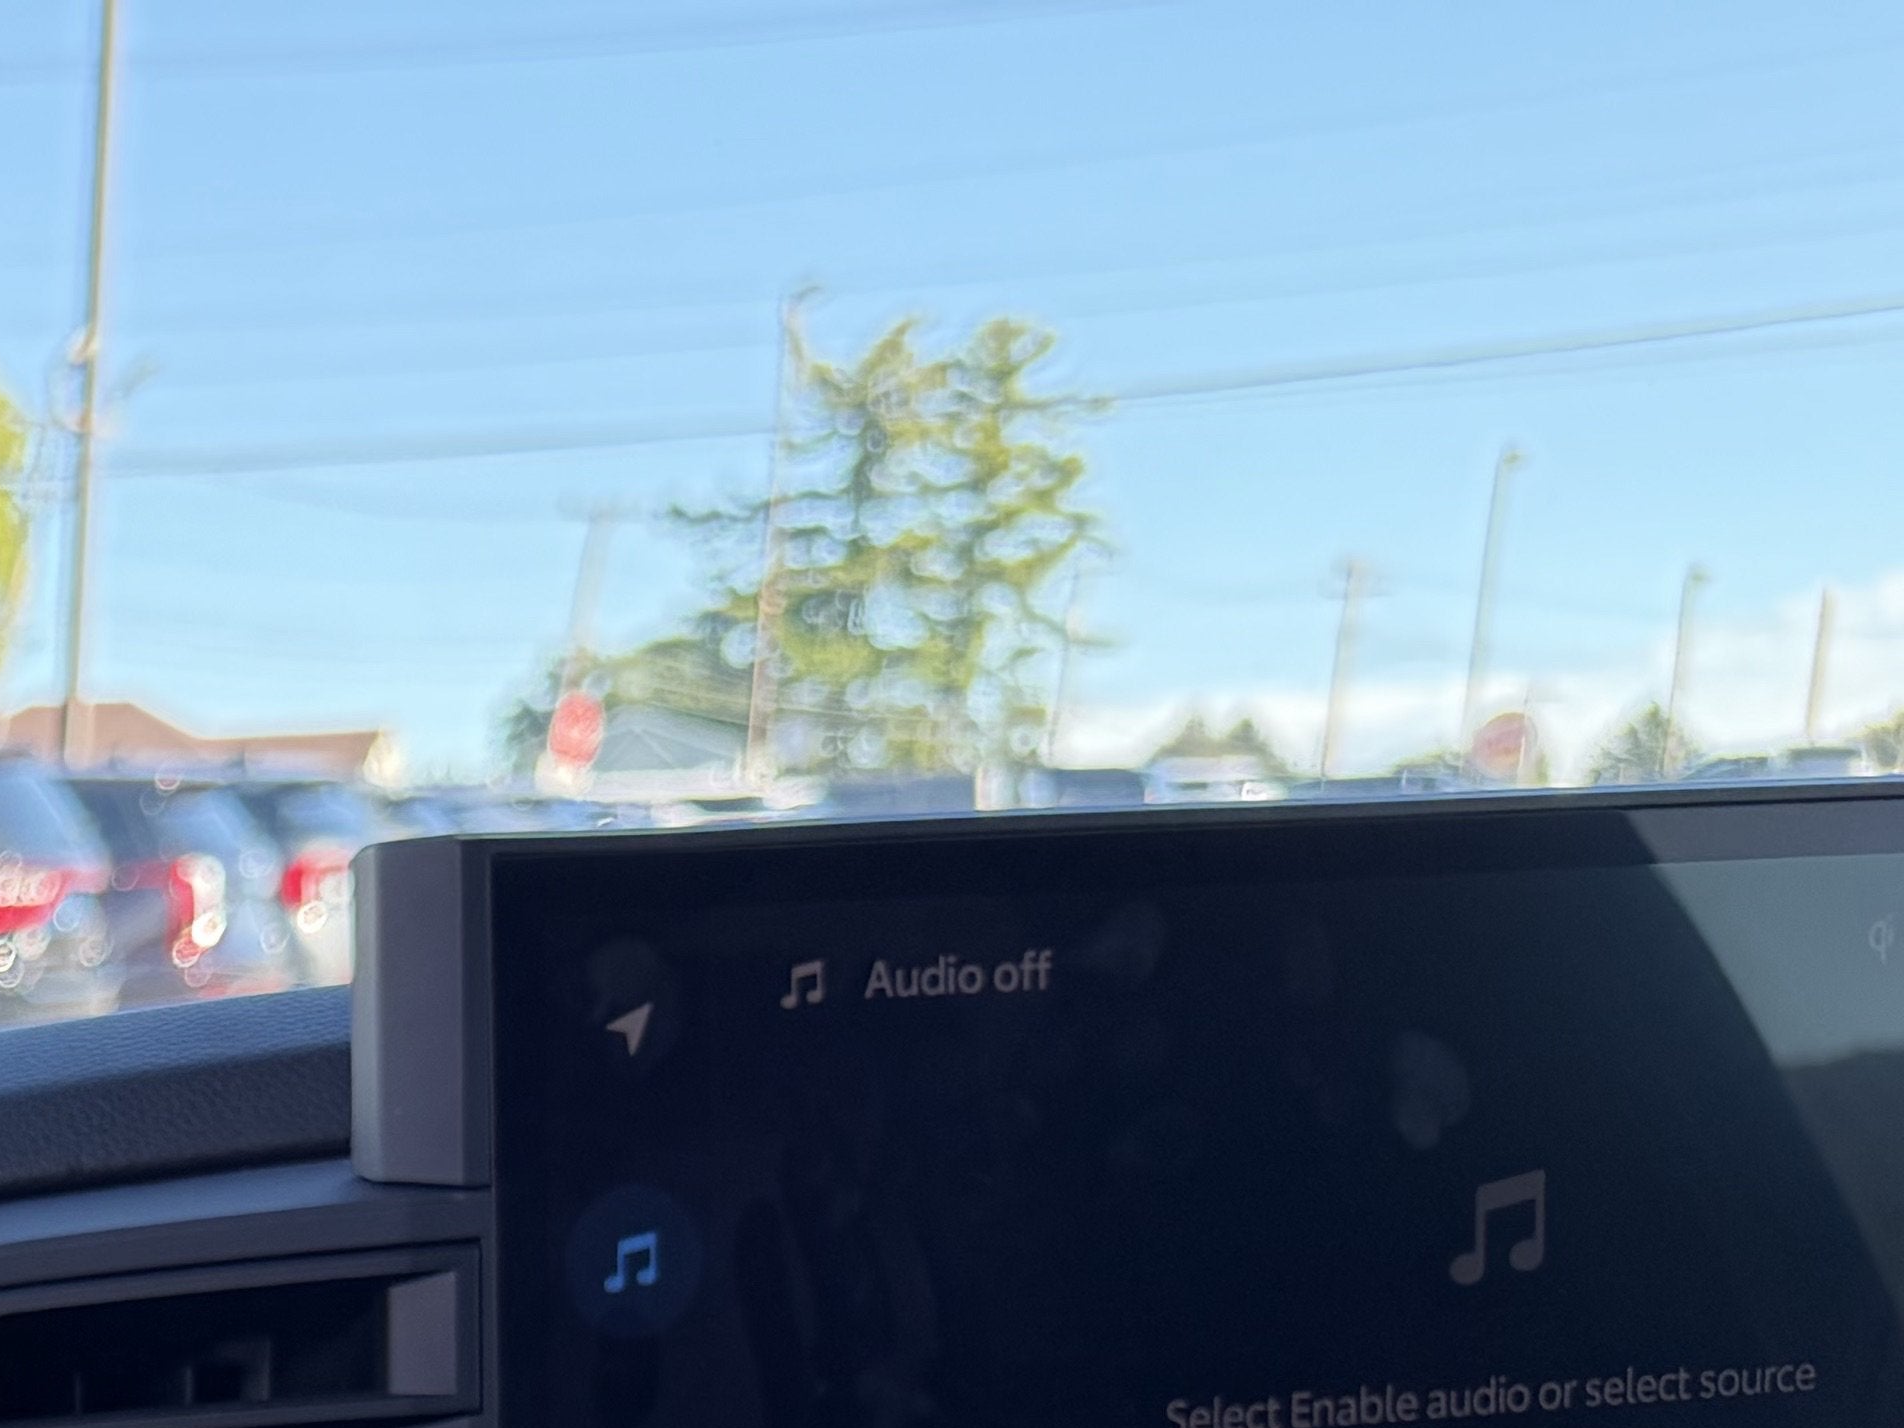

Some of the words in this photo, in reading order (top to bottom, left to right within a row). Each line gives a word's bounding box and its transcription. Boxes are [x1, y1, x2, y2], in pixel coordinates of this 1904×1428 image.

[863, 955, 984, 999] Audio
[993, 949, 1054, 993] off
[1426, 1374, 1533, 1419] audio
[1538, 1379, 1580, 1410] or
[1584, 1366, 1691, 1407] select
[1699, 1361, 1817, 1399] source
